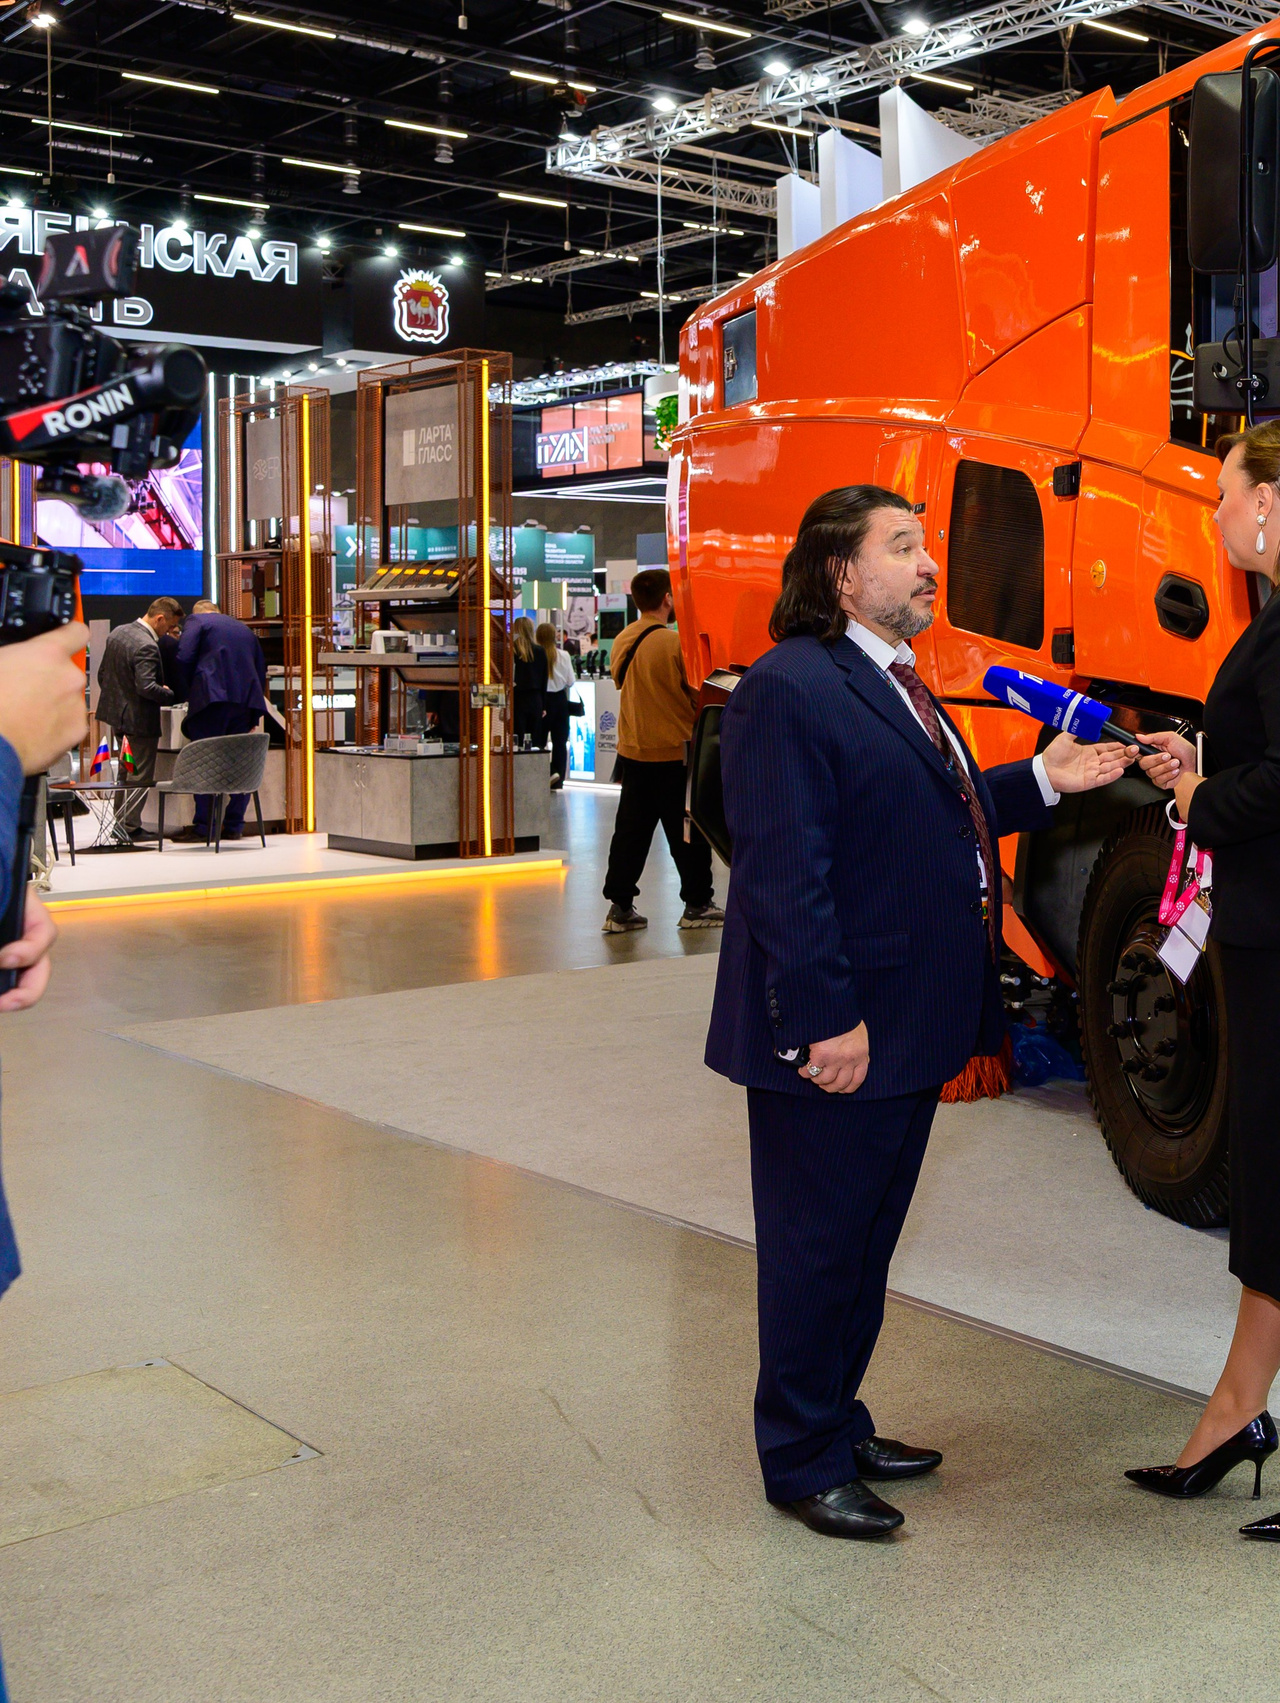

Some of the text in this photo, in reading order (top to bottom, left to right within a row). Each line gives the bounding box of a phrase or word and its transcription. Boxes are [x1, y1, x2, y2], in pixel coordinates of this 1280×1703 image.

[42, 383, 135, 437] RONIN
[418, 423, 454, 445] ЛАРТА
[417, 444, 453, 465] ГЛАСС
